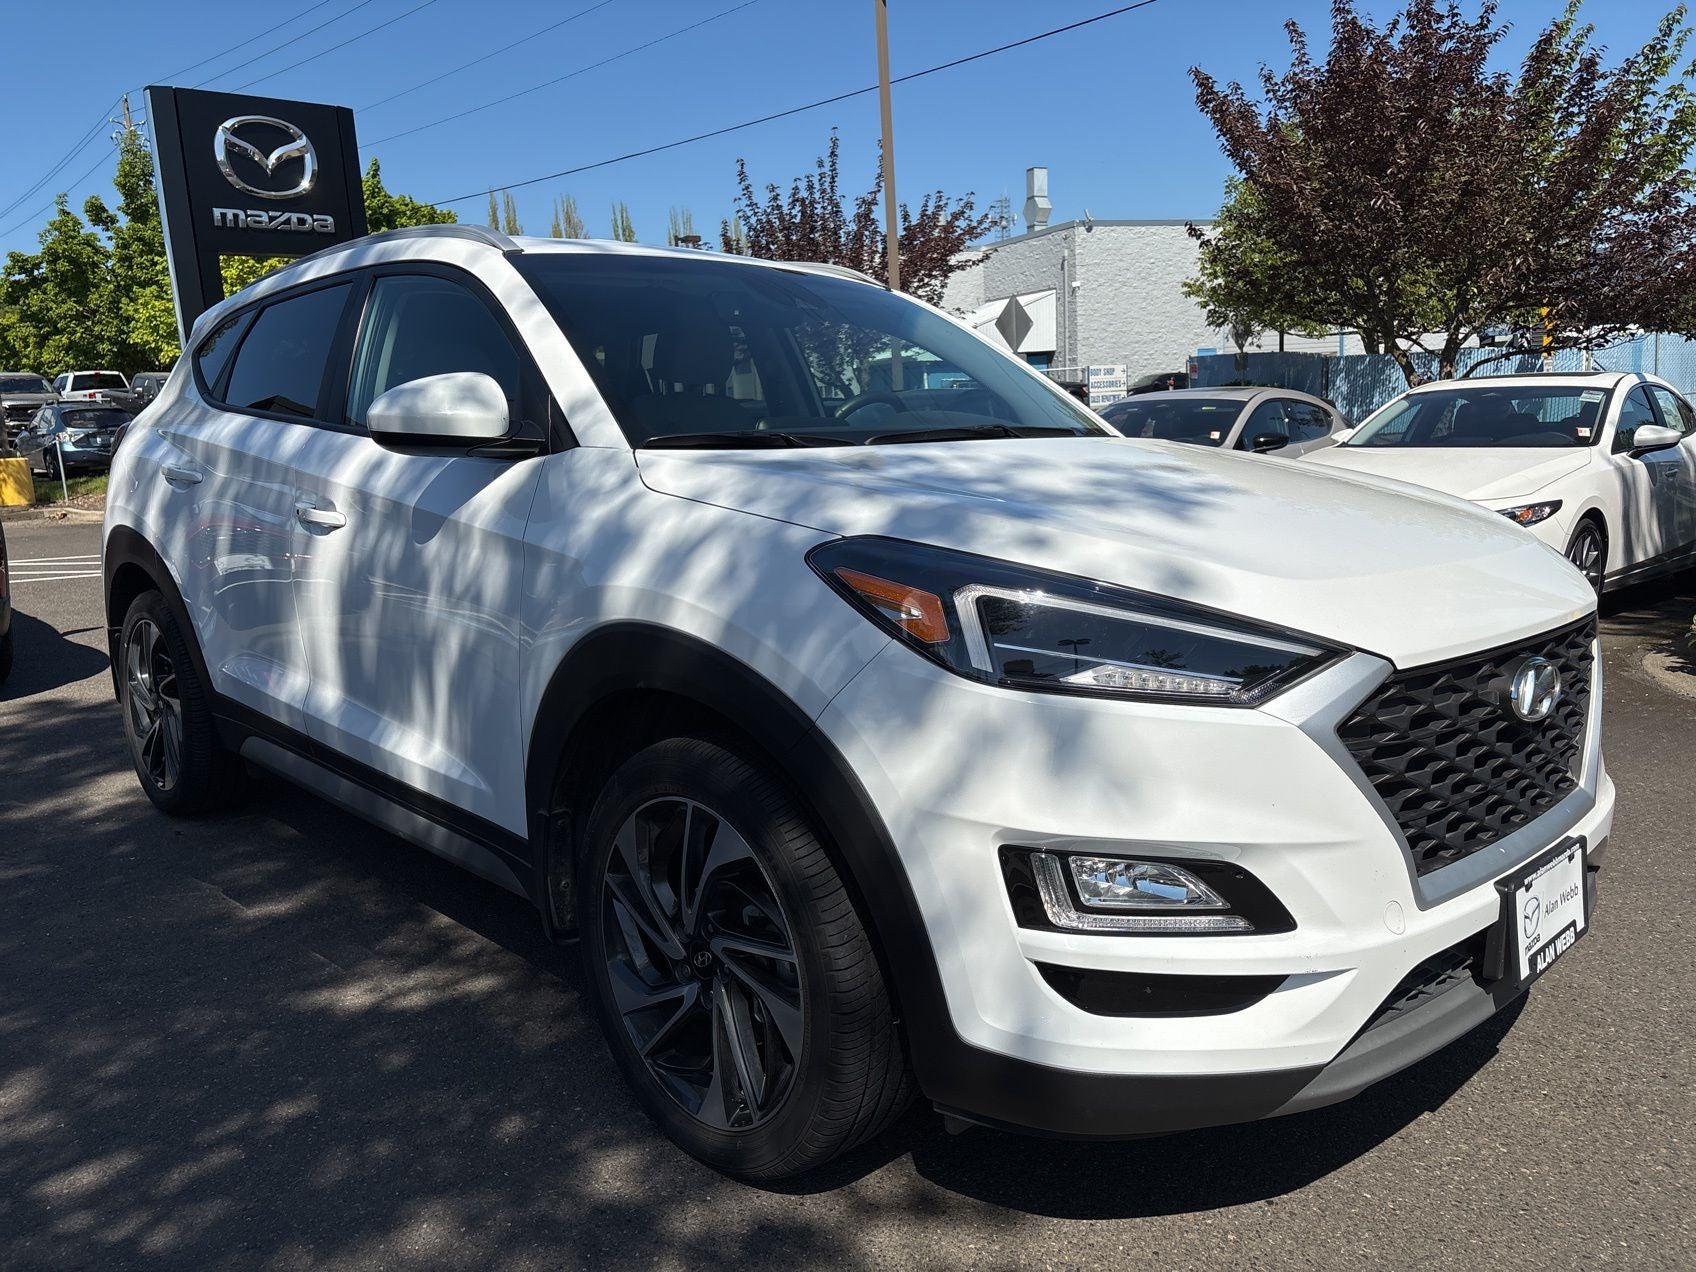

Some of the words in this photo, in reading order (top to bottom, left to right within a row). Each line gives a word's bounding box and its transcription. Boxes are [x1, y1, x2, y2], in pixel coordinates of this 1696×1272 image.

[212, 207, 336, 233] mazda
[1090, 368, 1102, 376] BODY
[1103, 367, 1115, 376] SHOP
[1091, 379, 1122, 389] ACCESSORIES
[1543, 899, 1559, 919] Alan
[1559, 883, 1579, 908] Webb
[1536, 943, 1555, 974] ALAN
[1555, 926, 1576, 955] WEBB
